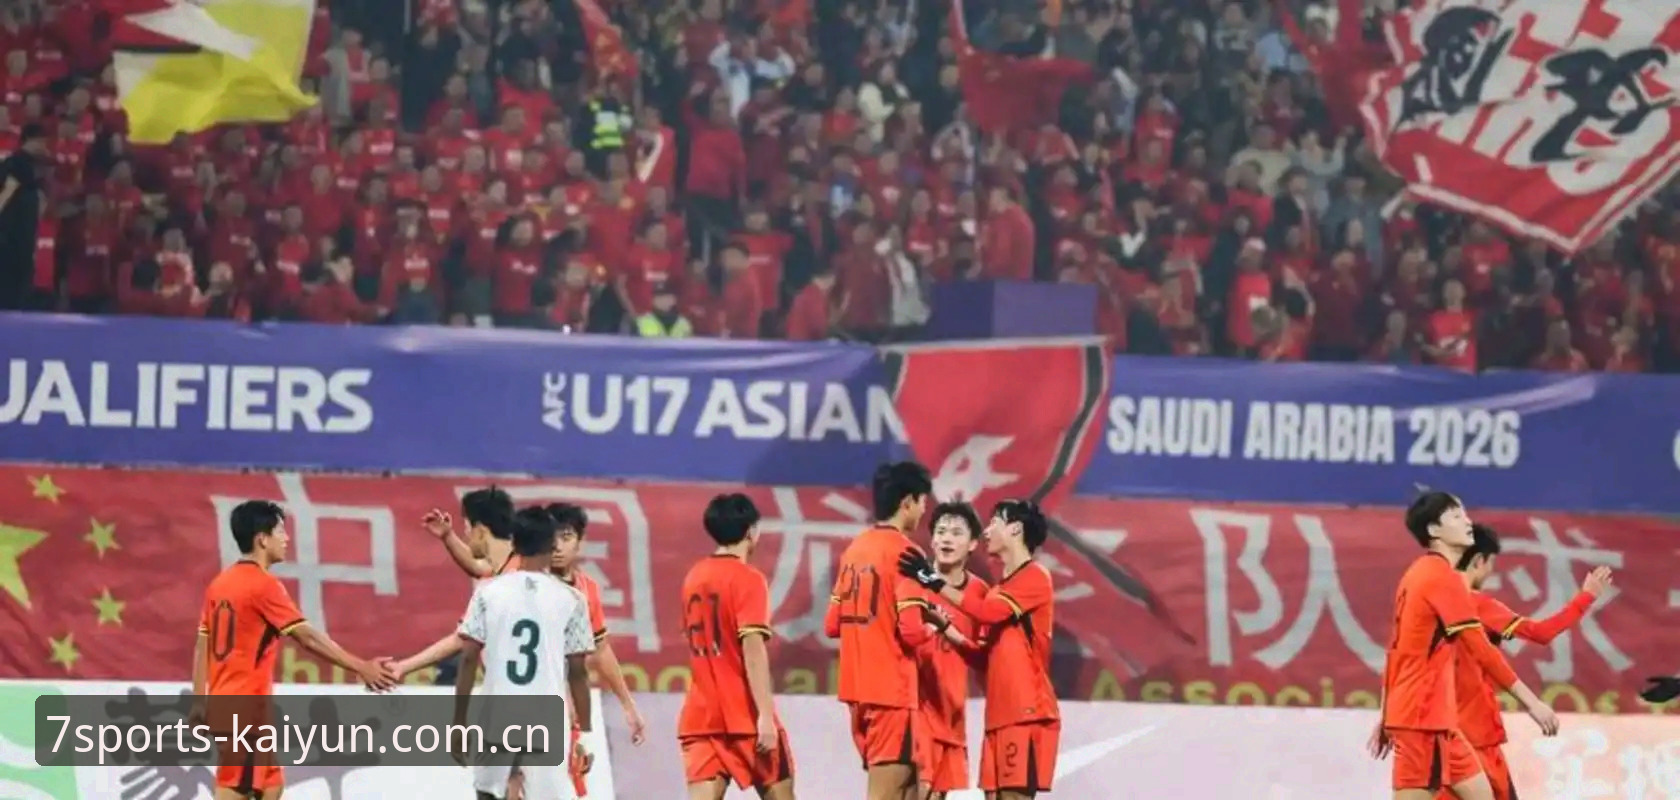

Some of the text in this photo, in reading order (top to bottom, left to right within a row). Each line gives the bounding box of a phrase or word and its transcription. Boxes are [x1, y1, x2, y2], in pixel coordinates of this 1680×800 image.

[542, 372, 911, 443] AFC U17 ASIAN
[1107, 396, 1520, 468] SAUDI ARABIA 2026
[506, 618, 541, 686] 3
